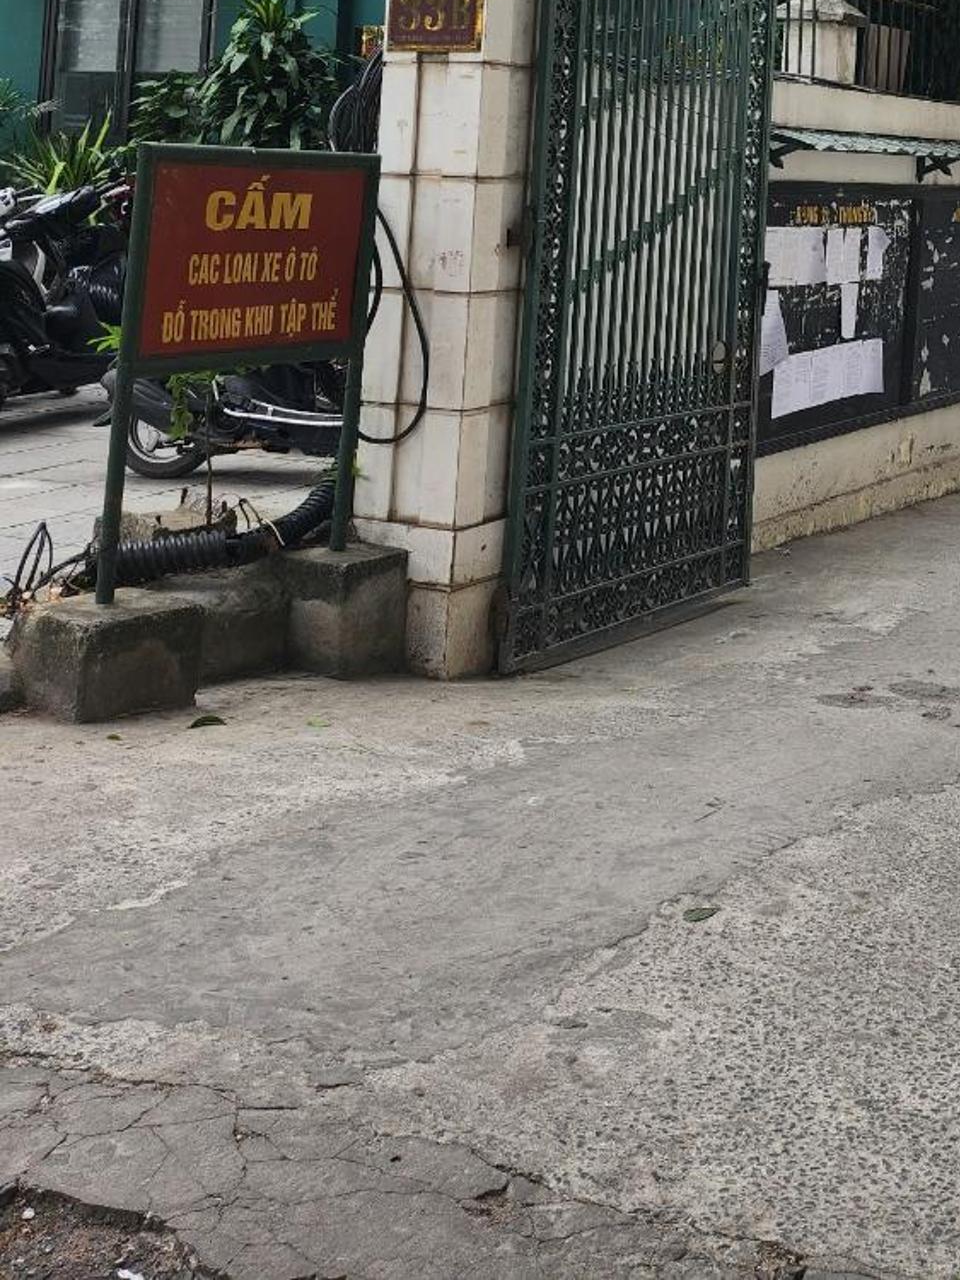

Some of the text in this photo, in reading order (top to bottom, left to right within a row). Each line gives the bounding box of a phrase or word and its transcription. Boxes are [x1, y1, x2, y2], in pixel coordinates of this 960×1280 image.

[204, 174, 313, 231] CẤM
[260, 251, 283, 283] XE
[284, 245, 297, 283] Ô
[299, 245, 319, 282] TÔ
[190, 306, 242, 341] TRONG
[244, 304, 274, 338] KHU
